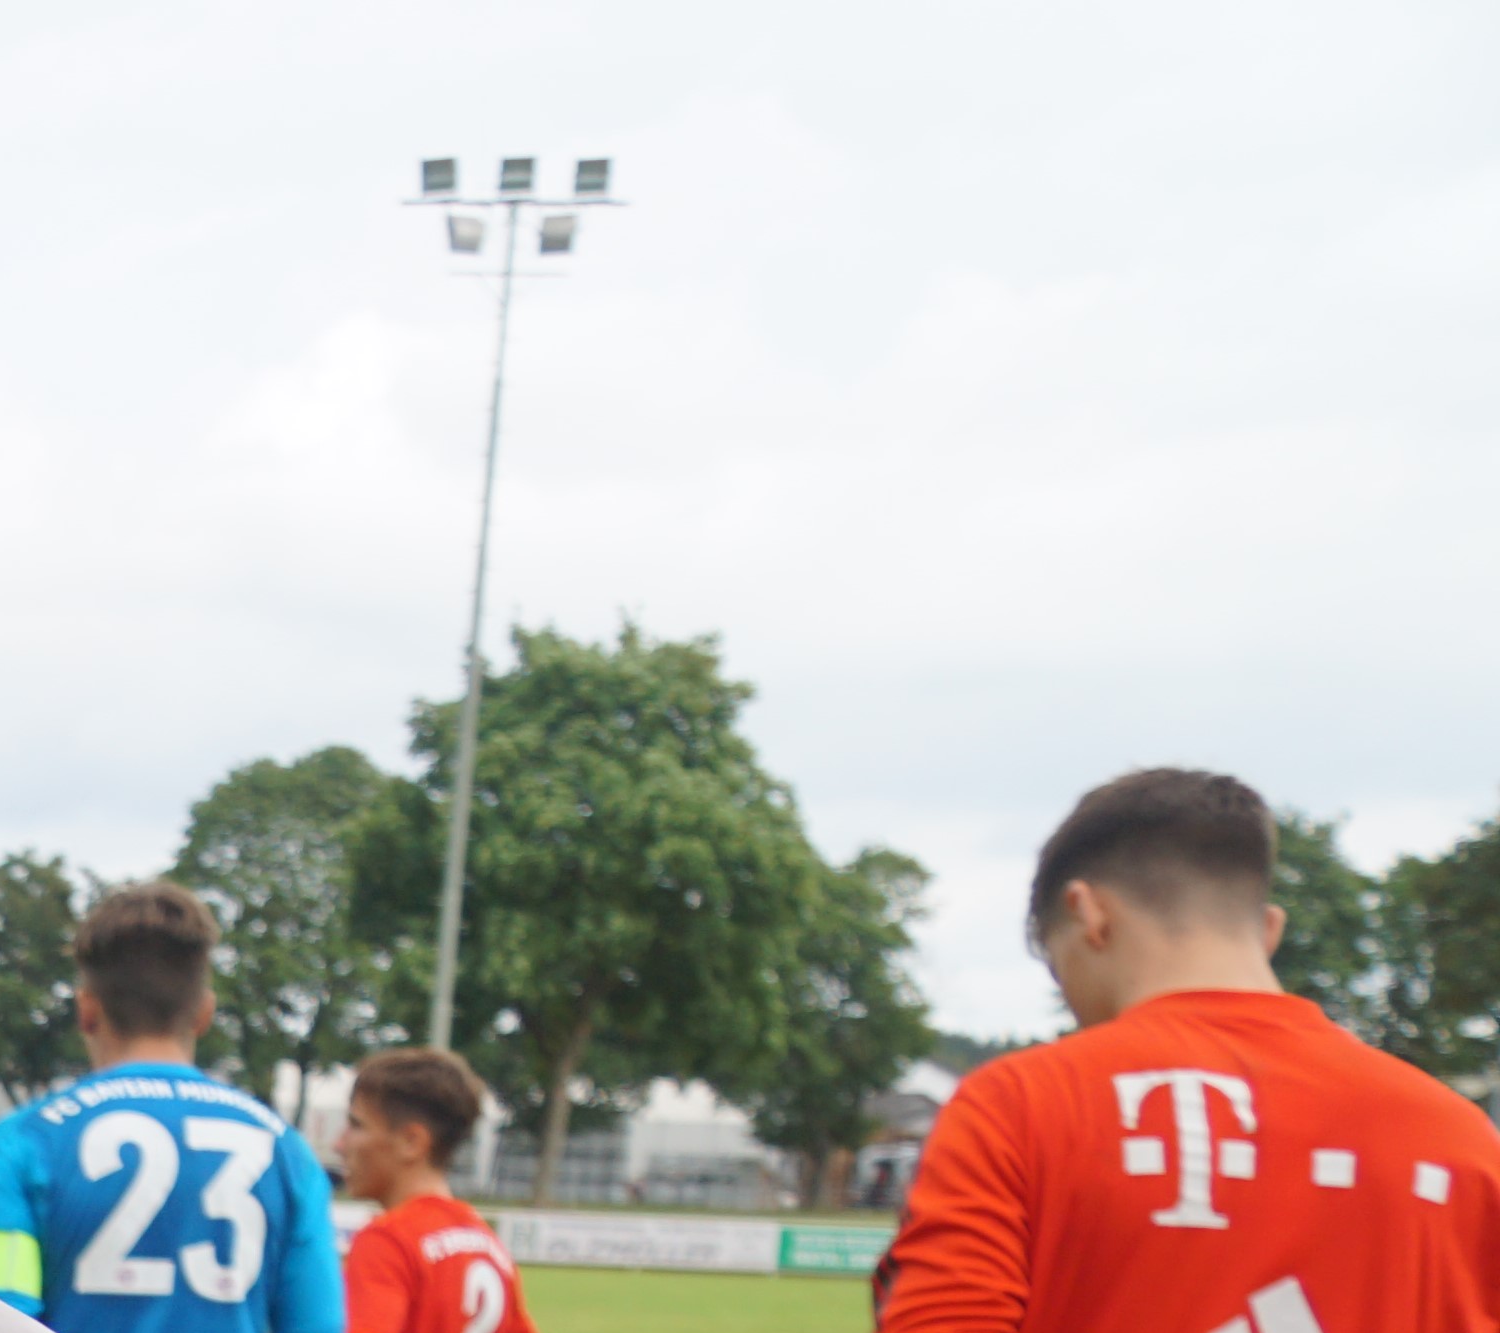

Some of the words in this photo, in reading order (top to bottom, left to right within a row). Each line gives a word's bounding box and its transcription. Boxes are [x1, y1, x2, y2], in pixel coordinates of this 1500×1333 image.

[40, 1096, 82, 1126] FC
[1111, 1067, 1258, 1230] T
[72, 1108, 276, 1304] 23
